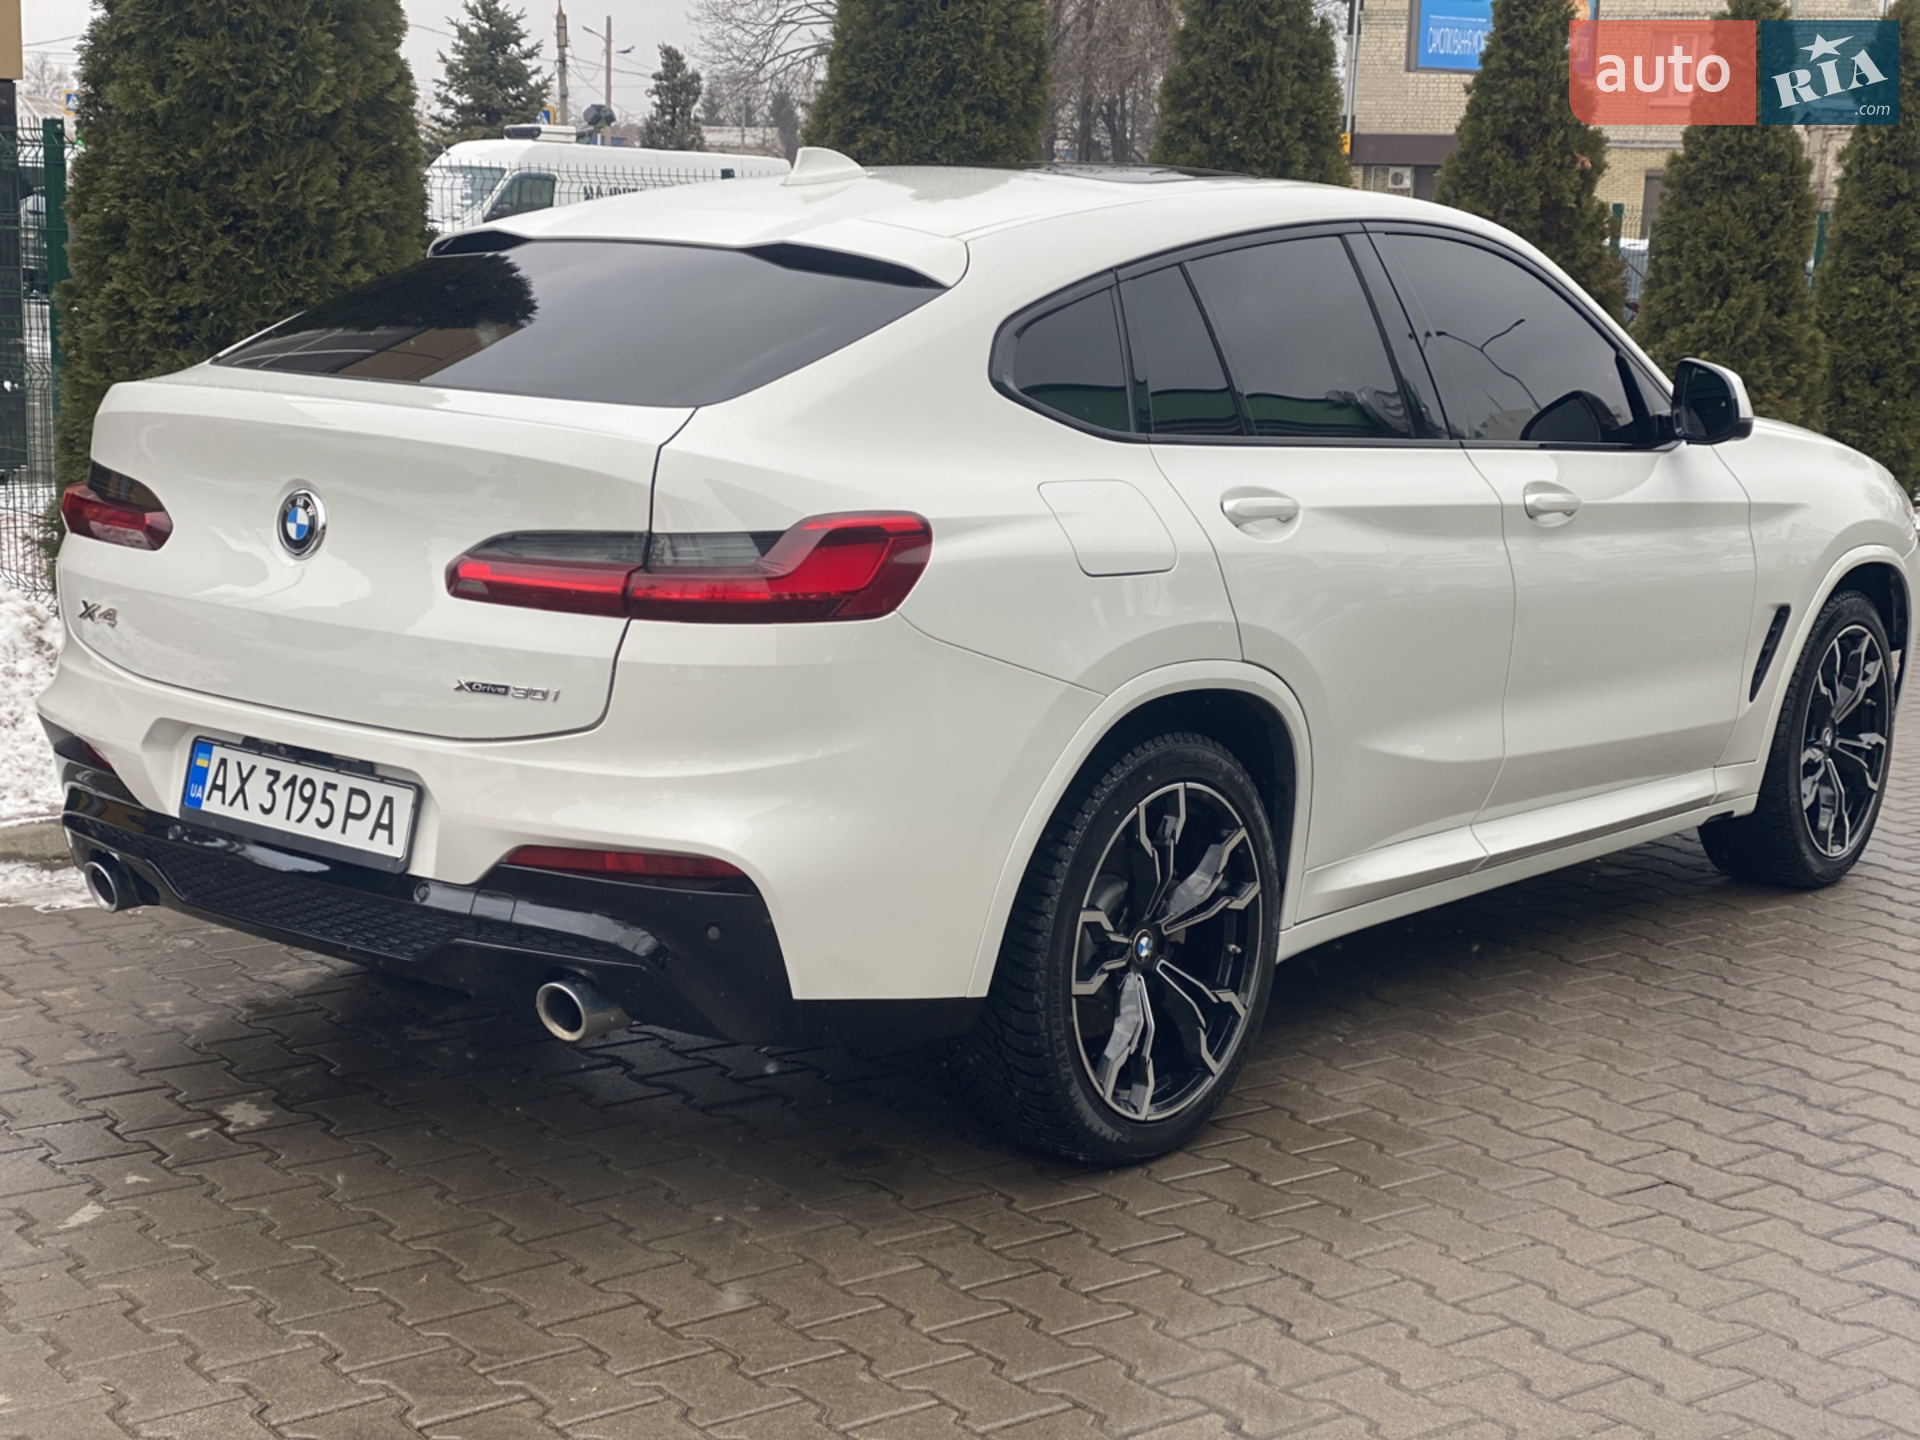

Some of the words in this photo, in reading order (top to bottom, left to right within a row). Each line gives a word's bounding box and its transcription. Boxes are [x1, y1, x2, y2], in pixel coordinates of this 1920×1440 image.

[284, 497, 316, 517] BMW
[78, 599, 118, 629] X4
[190, 783, 203, 800] UA
